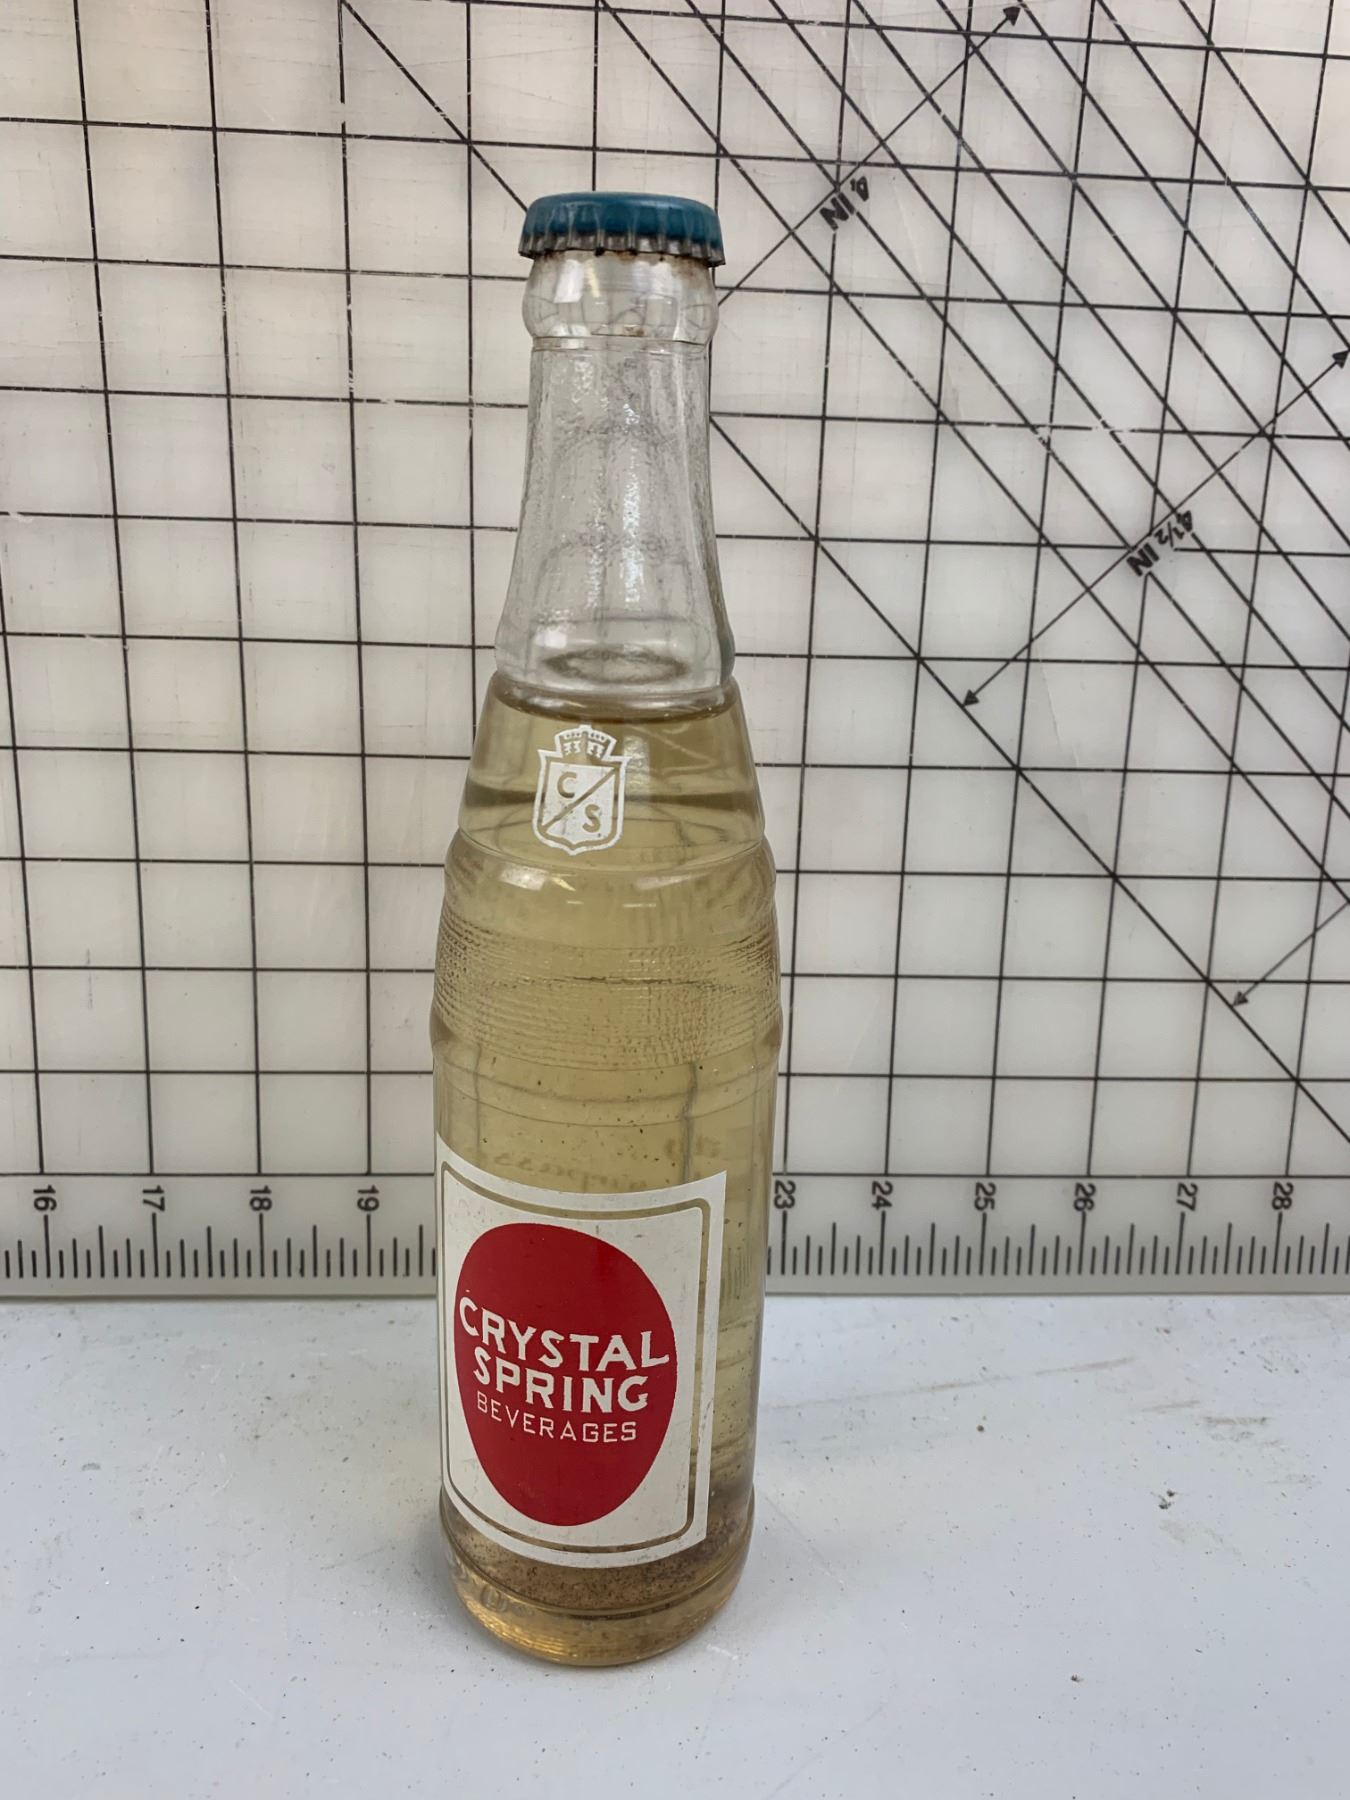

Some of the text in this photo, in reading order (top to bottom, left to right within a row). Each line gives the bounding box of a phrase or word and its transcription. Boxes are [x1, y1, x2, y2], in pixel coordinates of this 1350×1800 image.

[819, 191, 855, 231] IN
[1126, 542, 1160, 577] IN
[32, 1184, 58, 1212] 16
[142, 1185, 166, 1212] 17
[249, 1185, 273, 1212] 18
[356, 1184, 380, 1213] 19
[773, 1180, 797, 1210] 23
[871, 1180, 893, 1211] 24
[973, 1181, 997, 1212] 25
[1073, 1182, 1097, 1212] 26
[1176, 1182, 1199, 1212] 27
[1271, 1181, 1294, 1211] 28
[459, 1296, 670, 1372] CRYSTAL
[473, 1346, 649, 1414] SPRING
[476, 1390, 637, 1443] BEVERAGES
